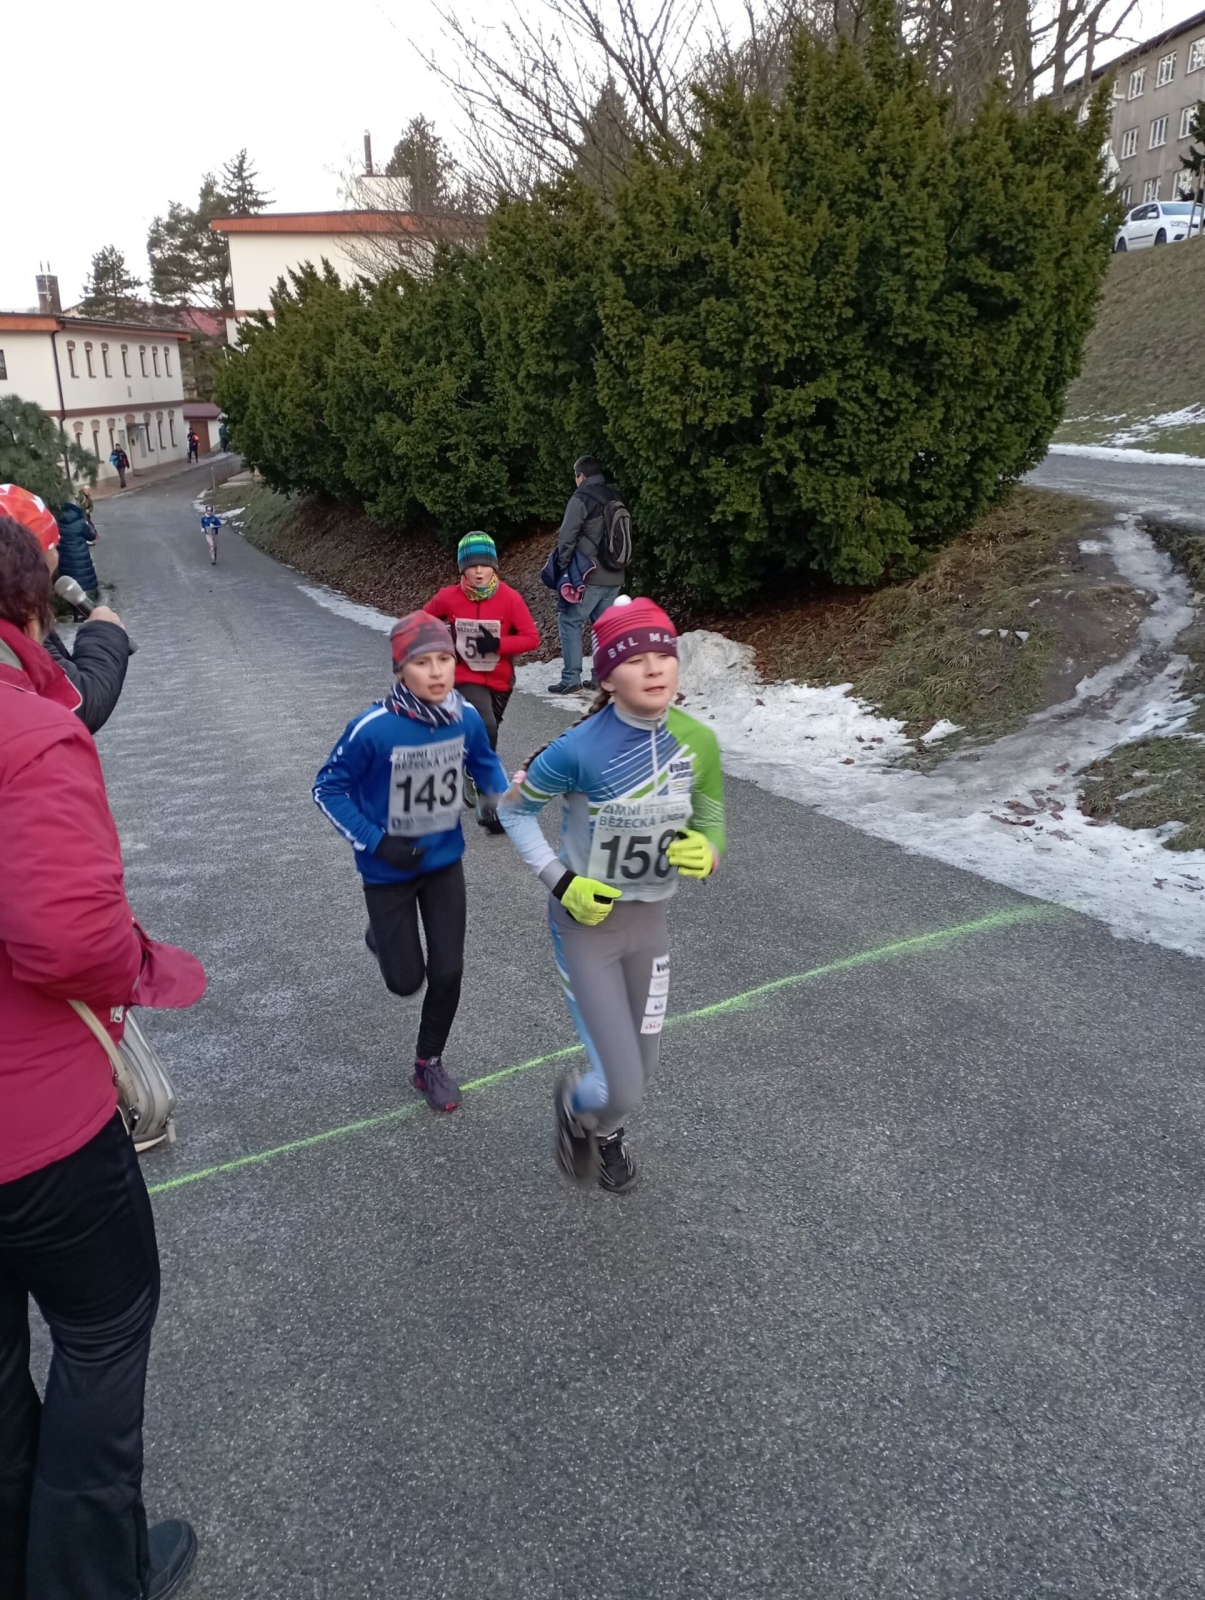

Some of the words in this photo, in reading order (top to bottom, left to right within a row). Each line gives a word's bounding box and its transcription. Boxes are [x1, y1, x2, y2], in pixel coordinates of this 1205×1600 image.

[607, 637, 639, 659] SKL
[396, 767, 457, 814] 143
[598, 815, 656, 829] BĚŽECKÁ
